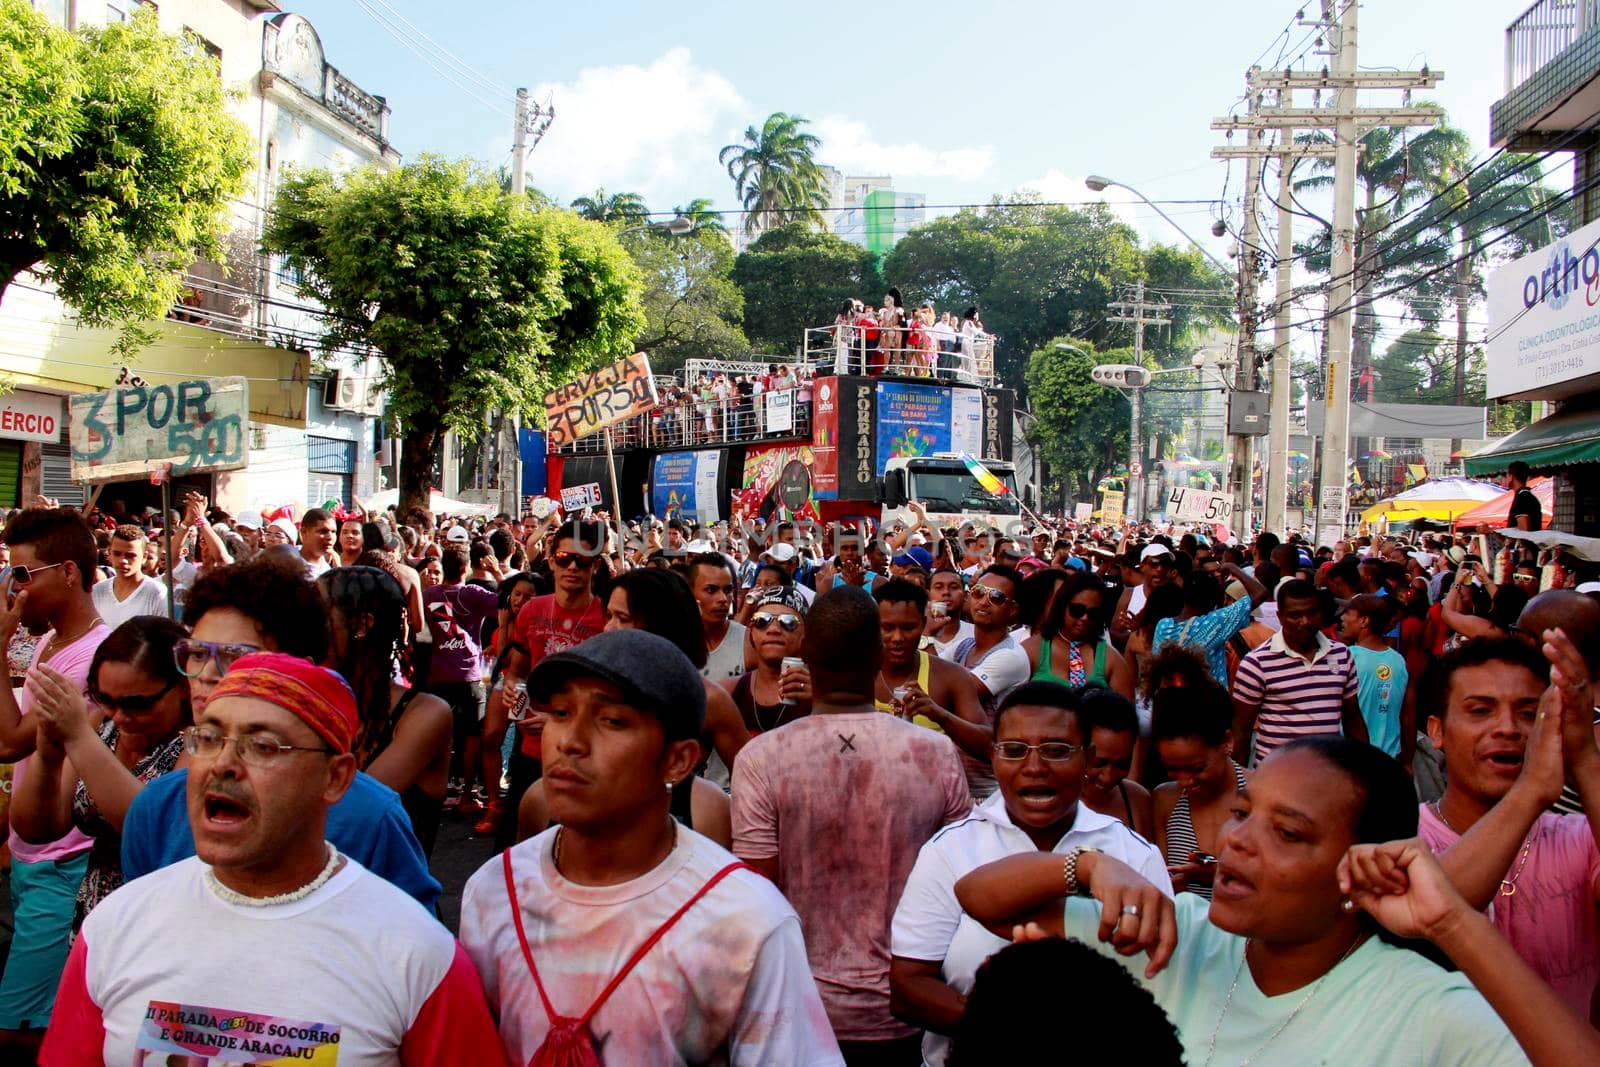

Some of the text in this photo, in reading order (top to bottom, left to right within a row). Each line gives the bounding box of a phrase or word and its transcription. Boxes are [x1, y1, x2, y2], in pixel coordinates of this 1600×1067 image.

[543, 359, 640, 409] CERVEJA
[2, 406, 54, 434] ÉRCIO
[115, 380, 212, 436] POR
[1169, 487, 1186, 514] 4
[158, 1009, 219, 1029] PARADA
[244, 1022, 265, 1034] DE
[267, 1024, 340, 1044] SOCORRO
[160, 1028, 316, 1060] E GRANDE ARACAJU
